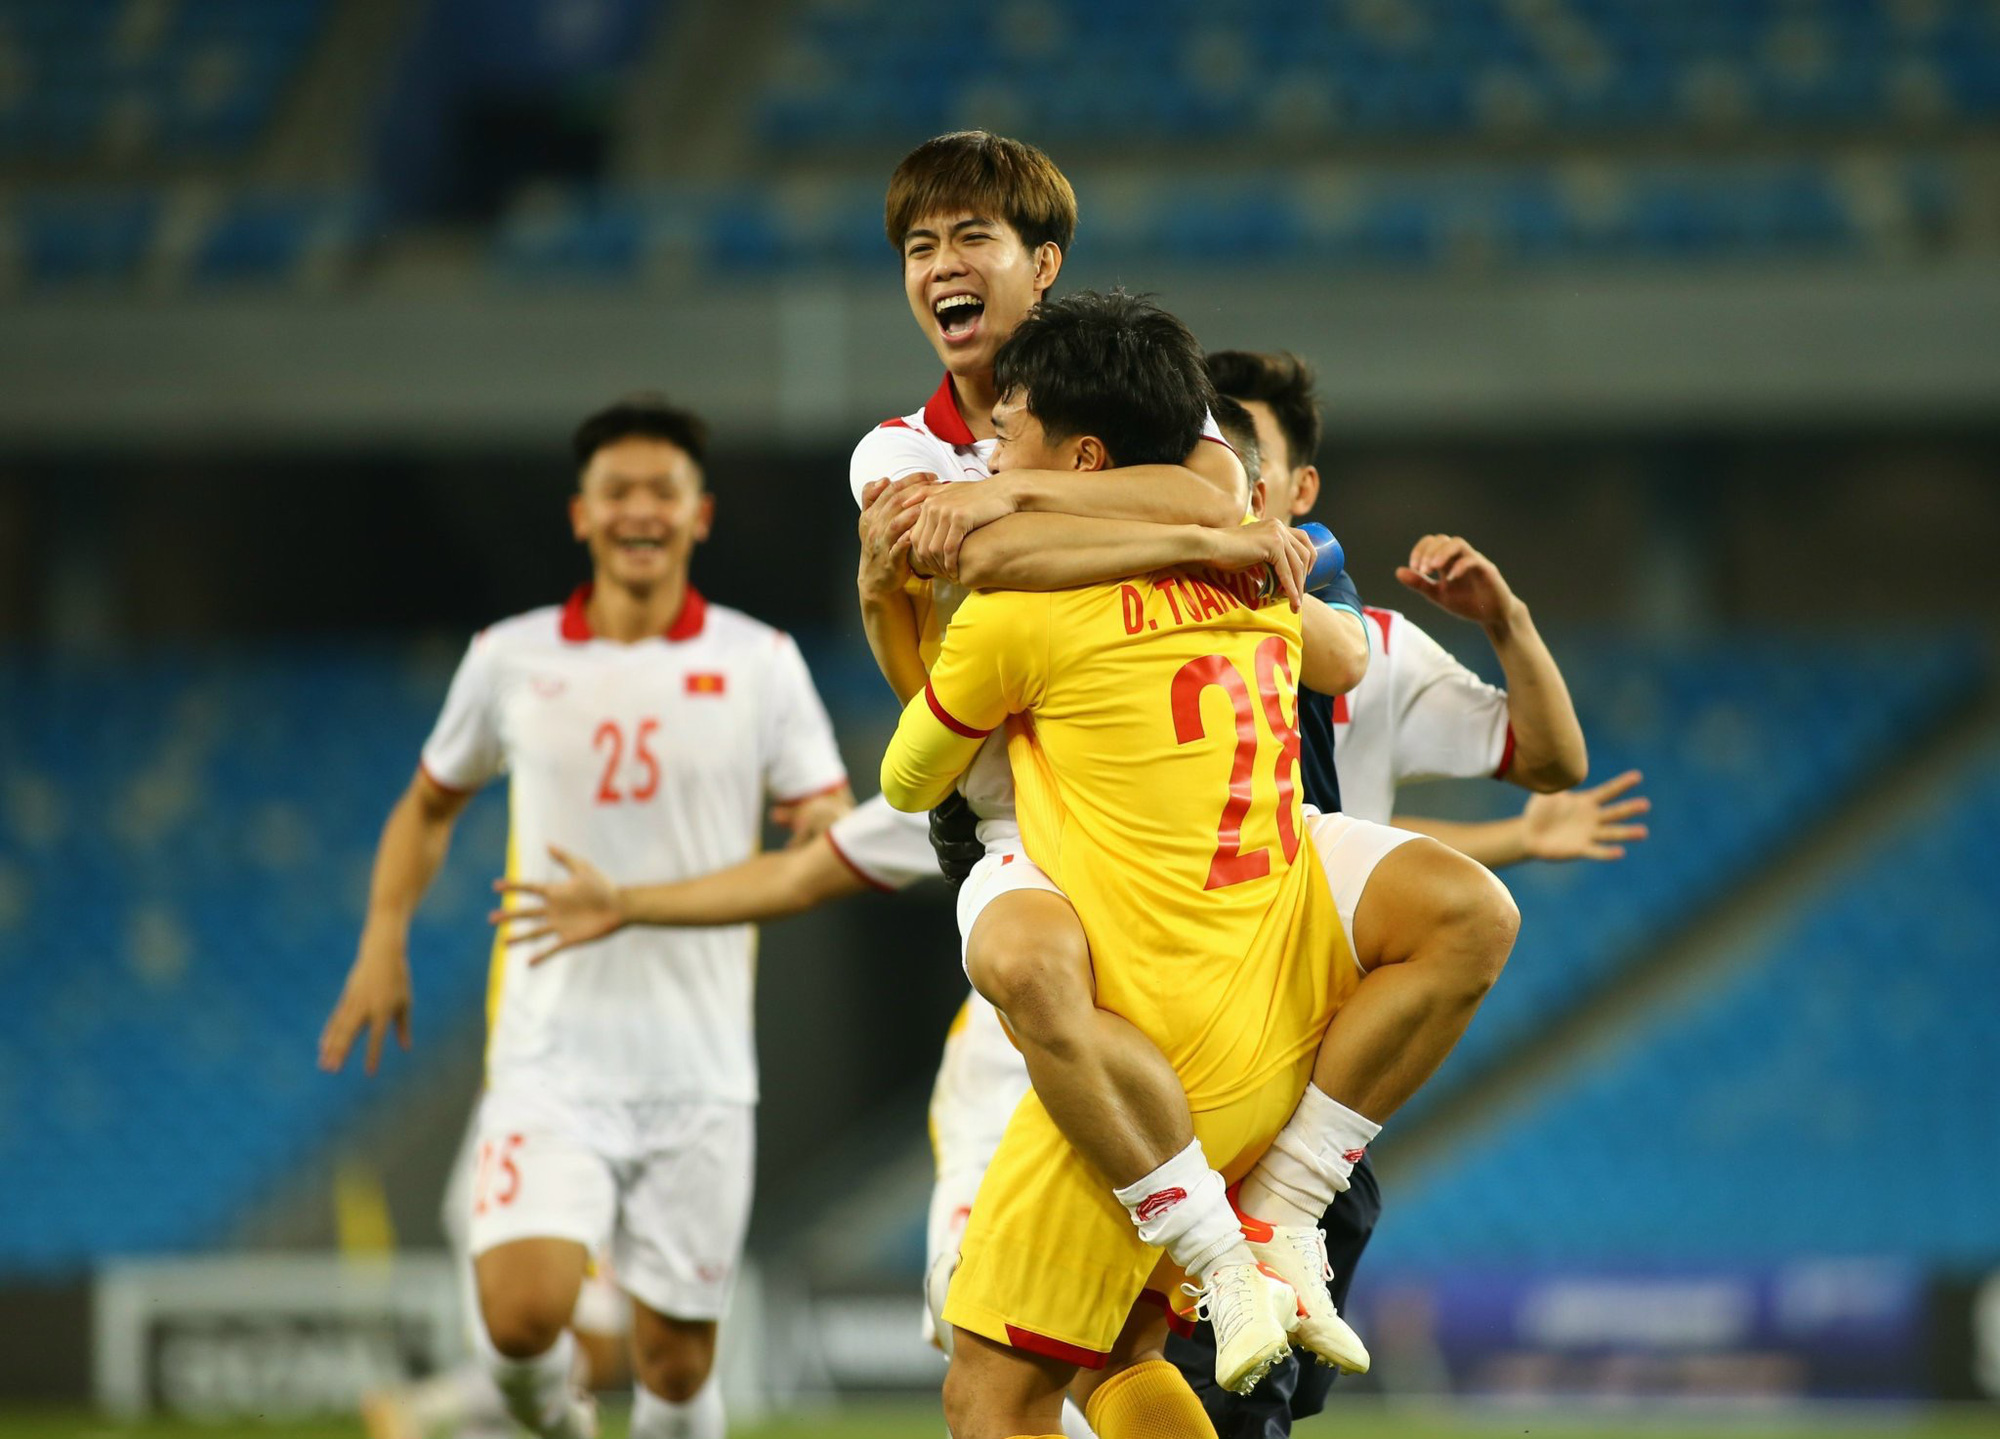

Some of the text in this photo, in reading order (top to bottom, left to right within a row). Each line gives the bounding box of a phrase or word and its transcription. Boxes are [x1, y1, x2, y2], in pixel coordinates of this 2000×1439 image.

[1121, 584, 1158, 636] D.
[593, 718, 662, 804] 25
[1170, 636, 1303, 891] 28
